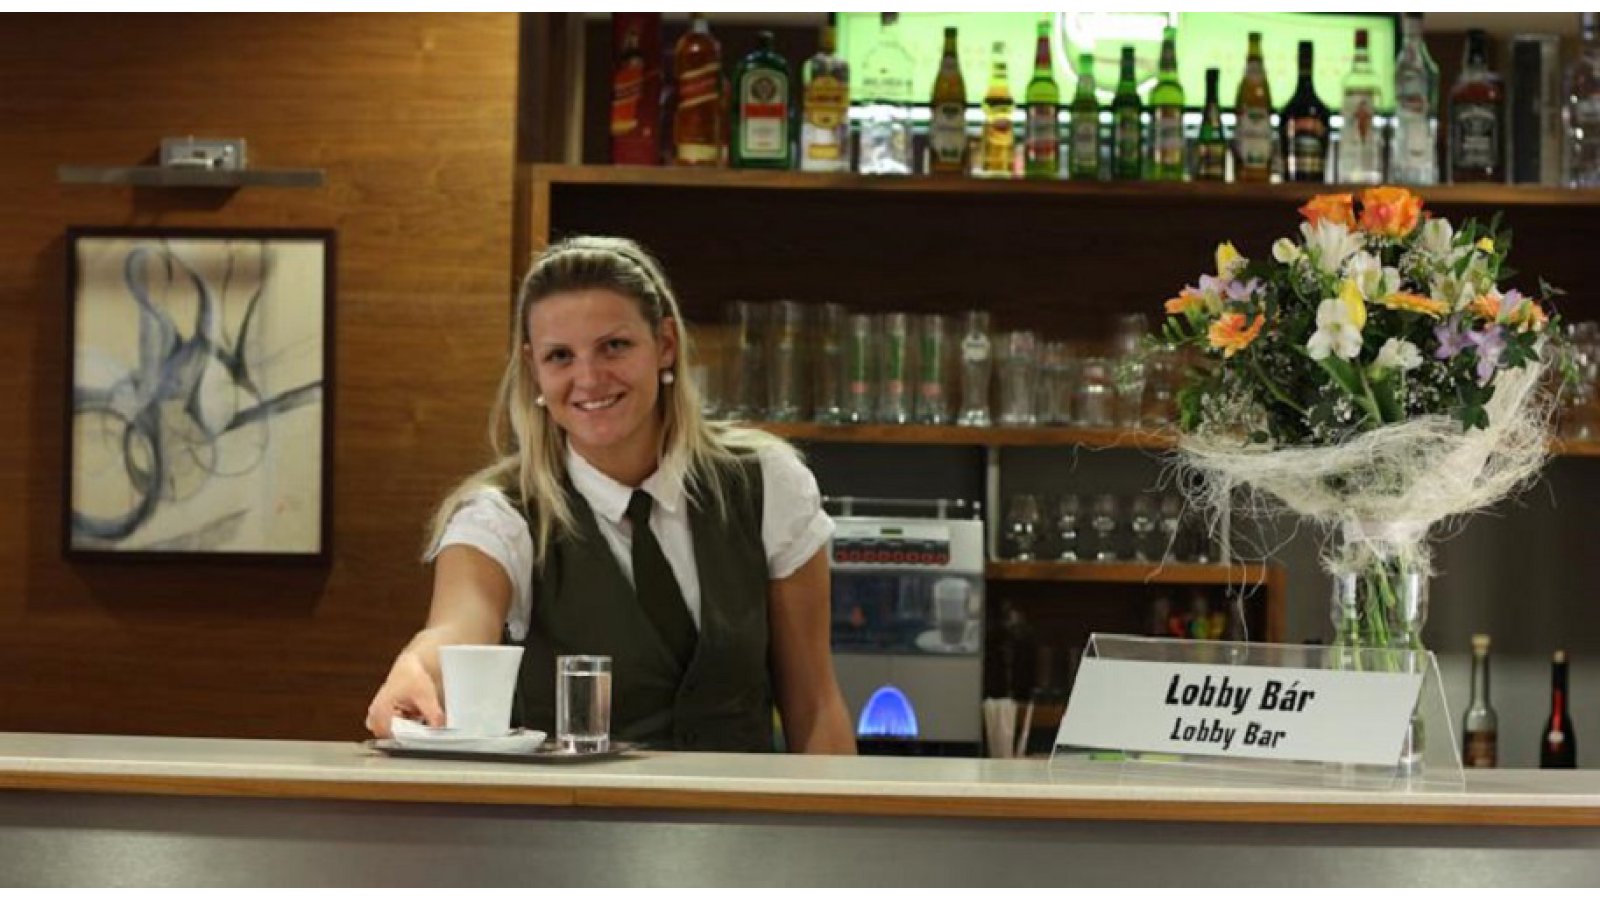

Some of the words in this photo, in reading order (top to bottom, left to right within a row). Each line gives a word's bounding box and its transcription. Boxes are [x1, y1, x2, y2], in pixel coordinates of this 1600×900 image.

[1165, 673, 1252, 715] Lobby
[1259, 680, 1315, 712] Bár
[1170, 717, 1236, 750] Lobby
[1243, 722, 1286, 748] Bar
